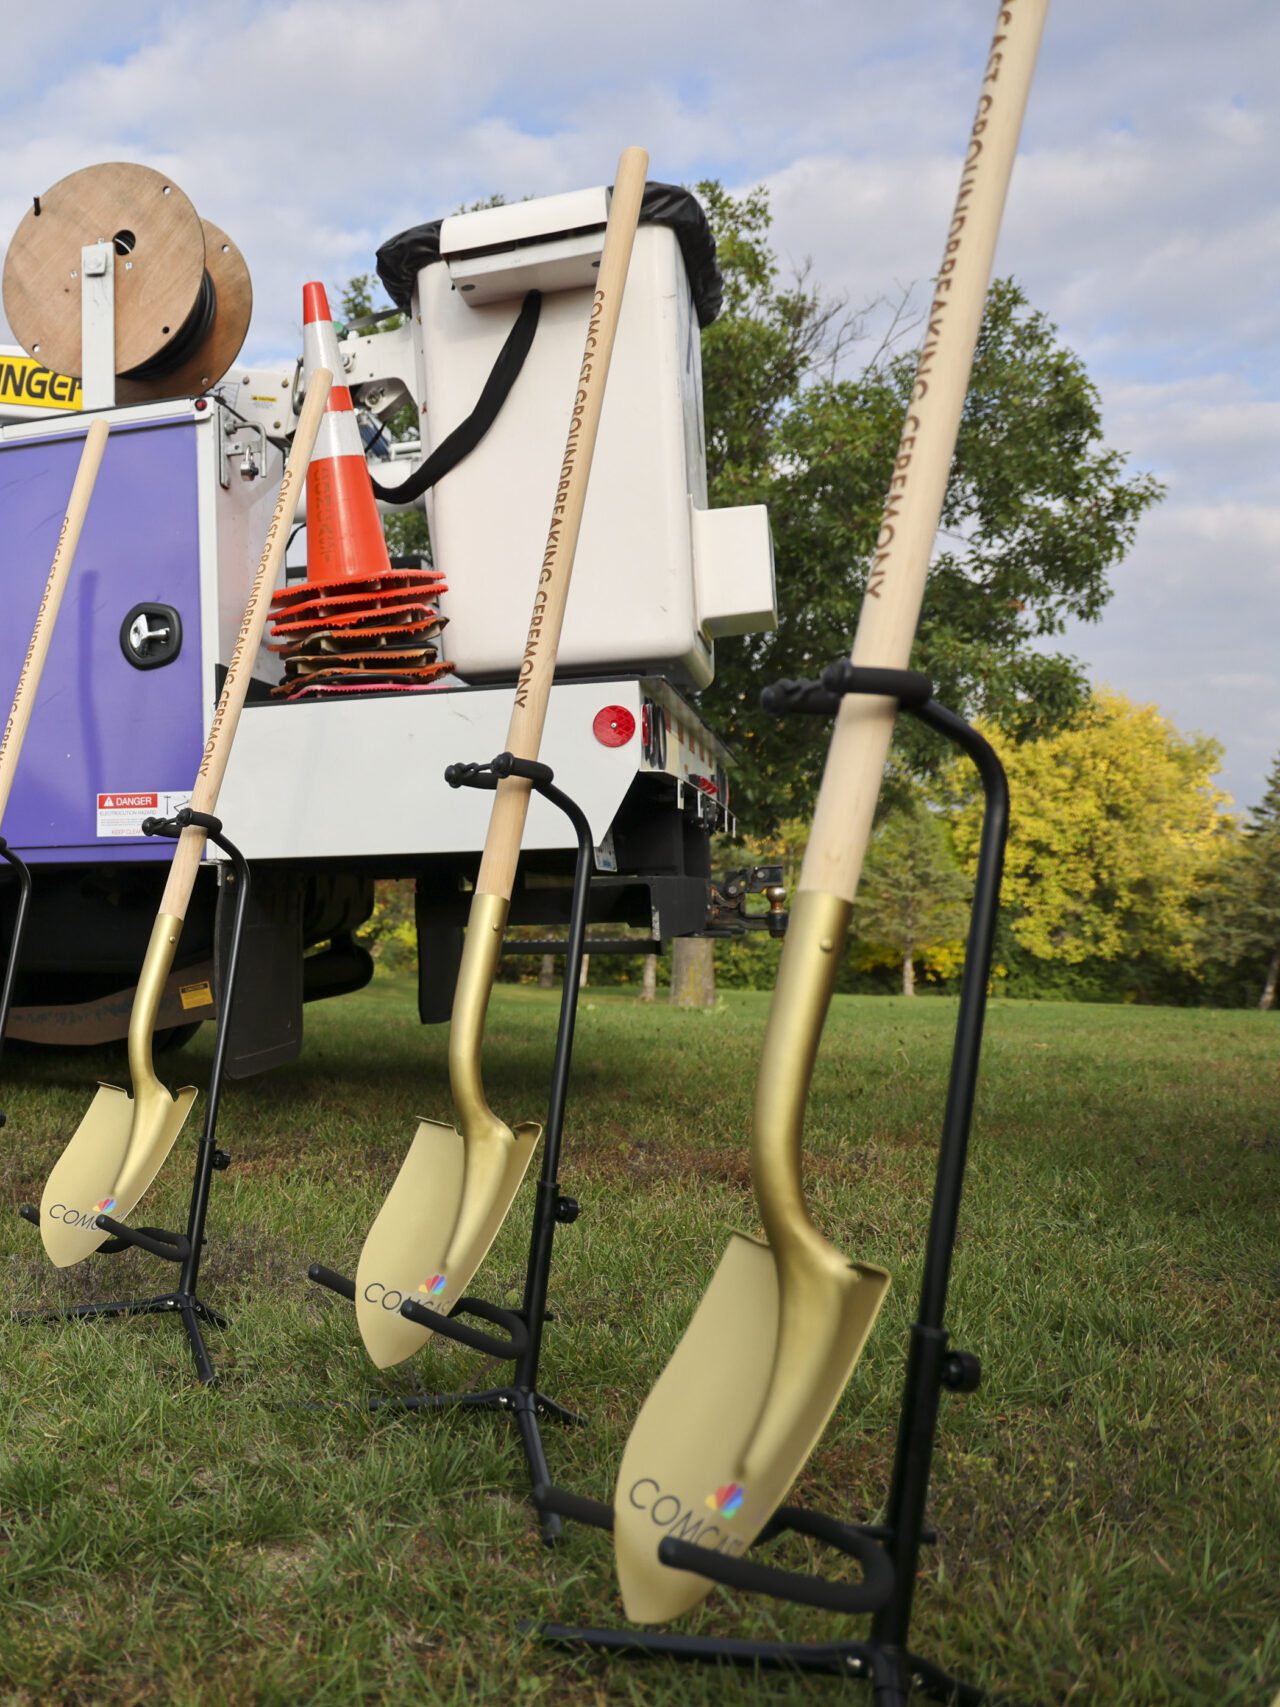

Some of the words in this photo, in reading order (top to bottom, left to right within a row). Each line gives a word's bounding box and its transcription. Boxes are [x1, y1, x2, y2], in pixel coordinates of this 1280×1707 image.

[578, 289, 606, 385] COMCAST
[266, 469, 293, 539] COMCAST
[538, 388, 588, 586] GROUNDBREAKING
[224, 541, 273, 687] GROUNDBREAKING
[514, 589, 549, 709] CEREMONY
[199, 689, 231, 778] CEREMONY
[116, 797, 151, 806] DANGER
